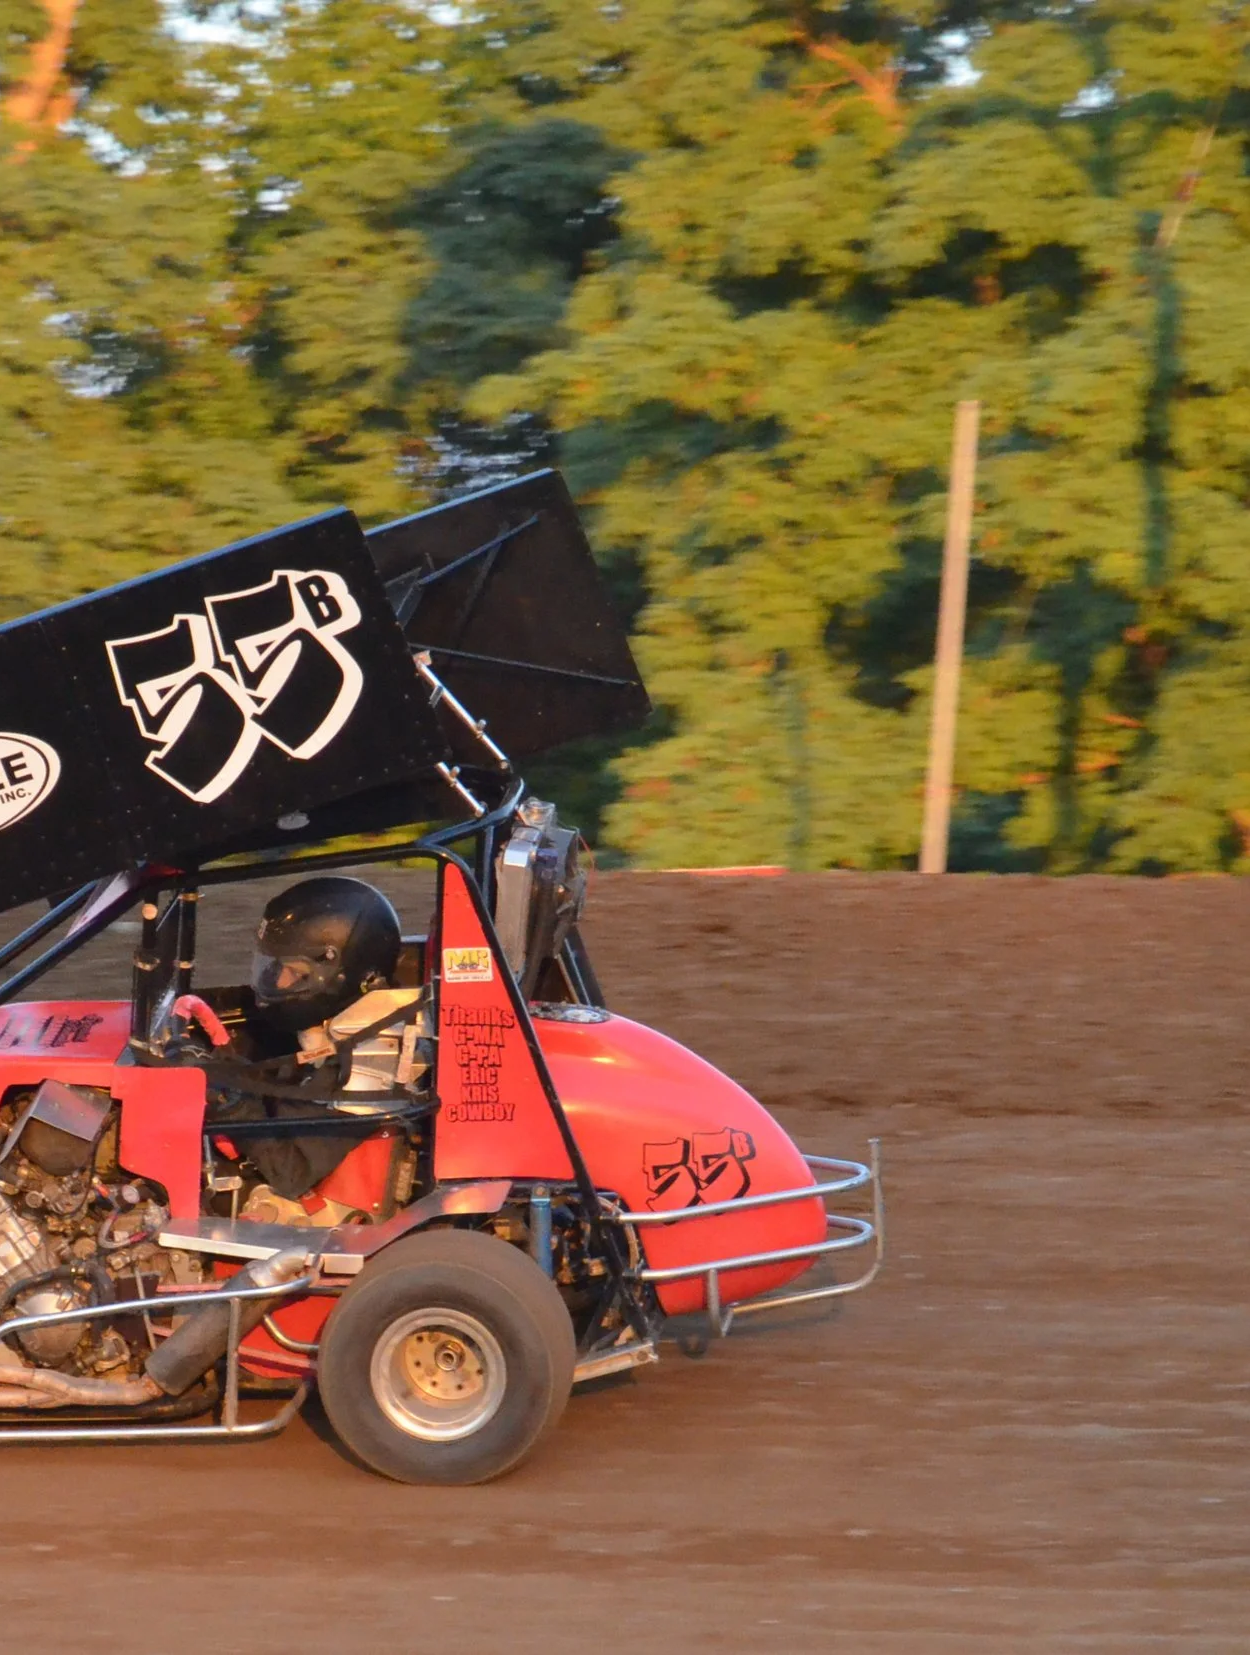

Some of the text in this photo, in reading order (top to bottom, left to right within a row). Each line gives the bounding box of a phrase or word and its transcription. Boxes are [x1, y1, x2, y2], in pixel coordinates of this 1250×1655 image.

[0, 787, 32, 805] INC.
[441, 1005, 515, 1029] Thanks
[452, 1025, 505, 1048] G-MA
[455, 1045, 502, 1068] G-PA
[461, 1067, 498, 1086] ERIC
[461, 1085, 499, 1104] KRIS
[446, 1103, 516, 1123] COWBOY
